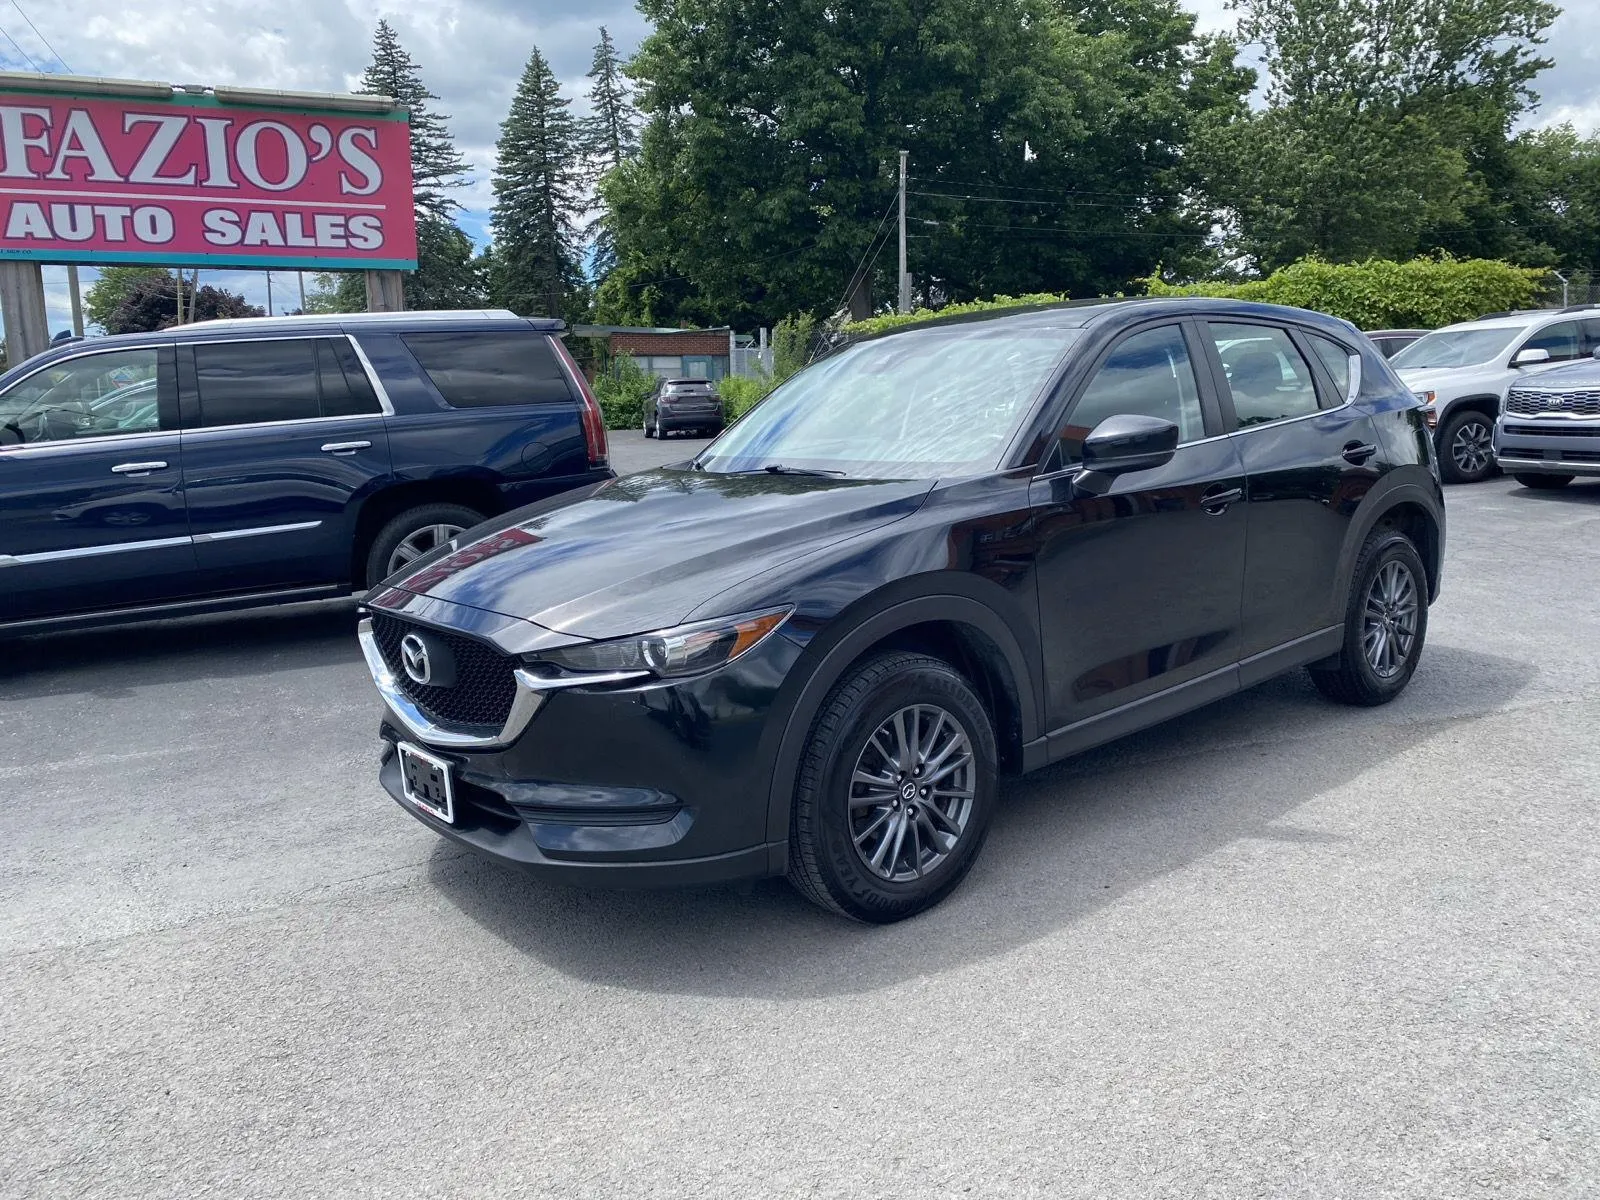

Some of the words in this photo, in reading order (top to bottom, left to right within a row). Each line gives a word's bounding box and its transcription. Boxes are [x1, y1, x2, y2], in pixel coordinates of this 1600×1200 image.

[0, 106, 384, 195] FAZIO'S
[3, 201, 175, 244] AUTO
[202, 207, 384, 250] SALES
